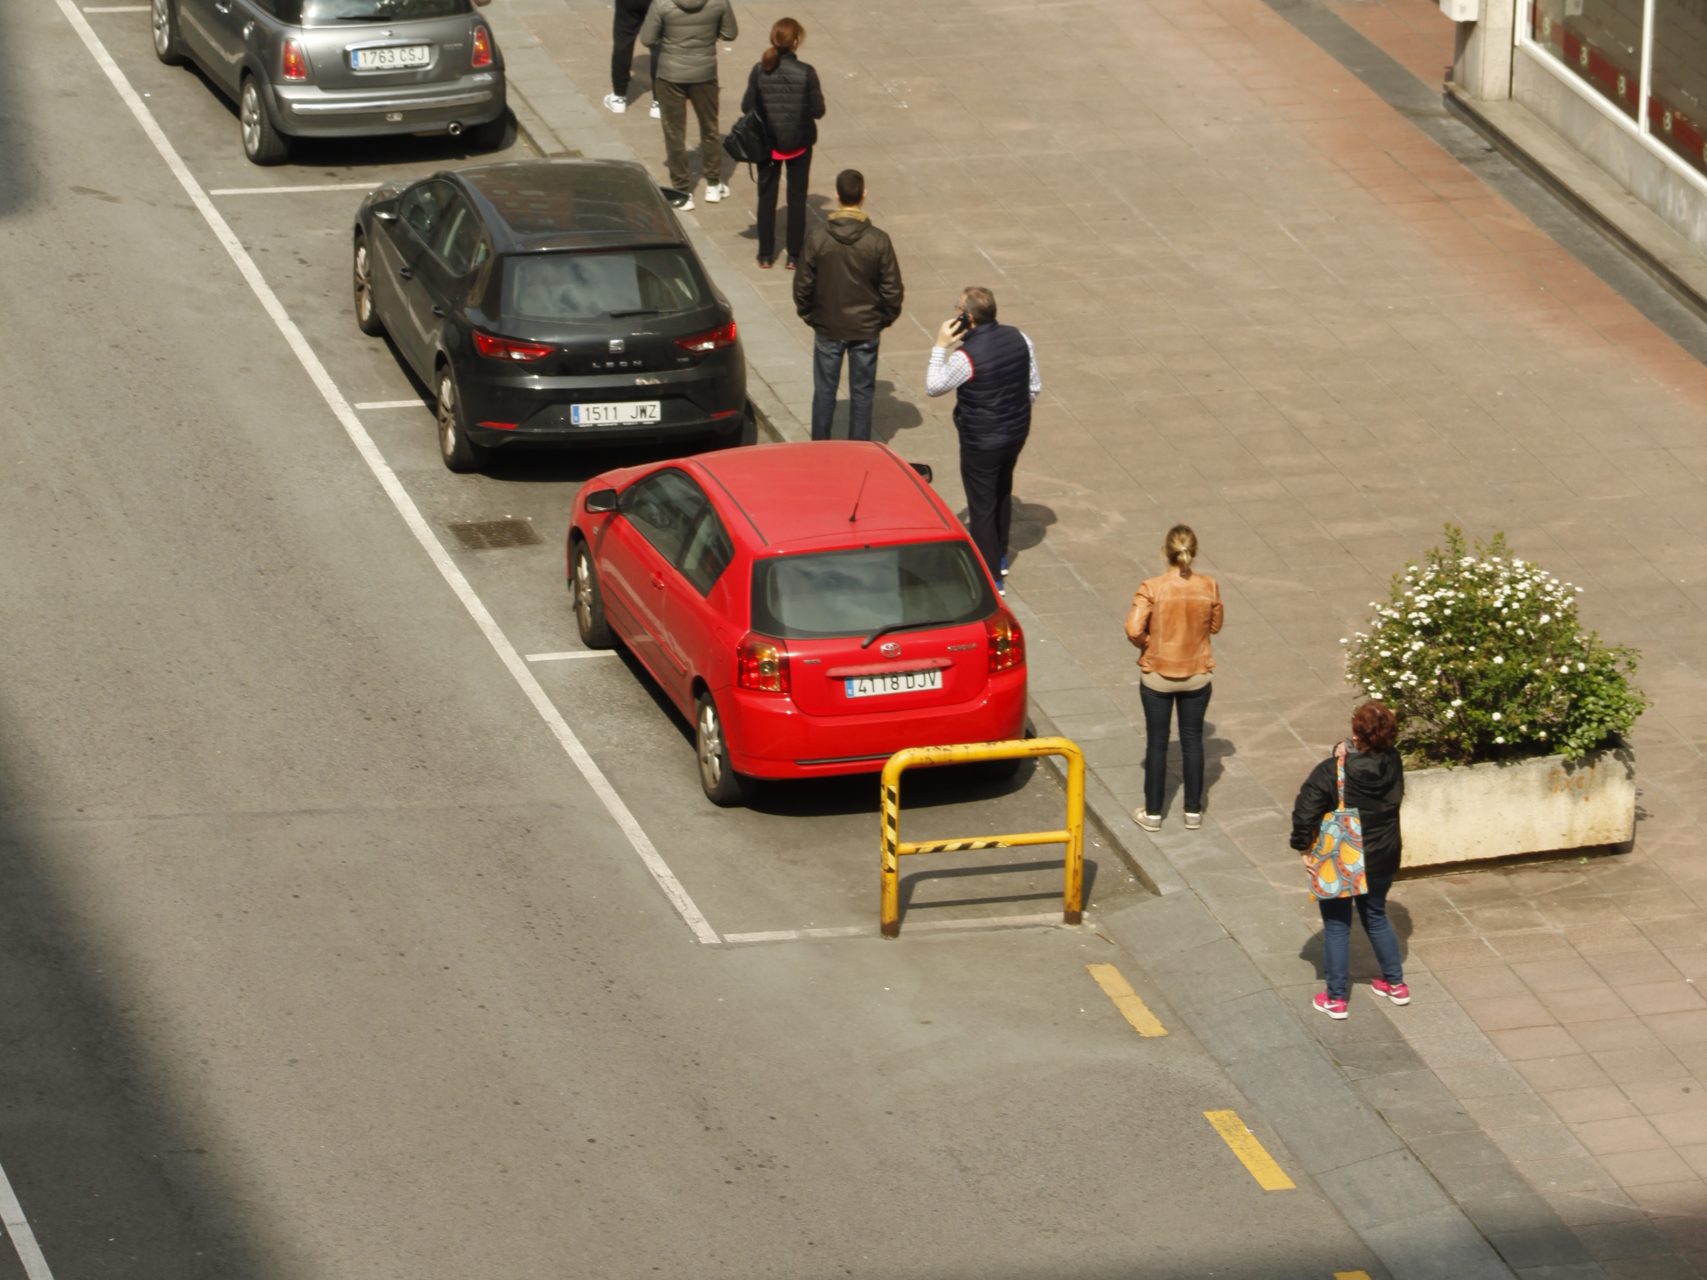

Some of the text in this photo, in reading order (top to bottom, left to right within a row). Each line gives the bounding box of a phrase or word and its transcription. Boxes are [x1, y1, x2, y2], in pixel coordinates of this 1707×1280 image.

[362, 47, 425, 65] 1763 CSJ
[584, 403, 657, 421] 1511 JWZ
[858, 670, 938, 694] 4118 DJV
